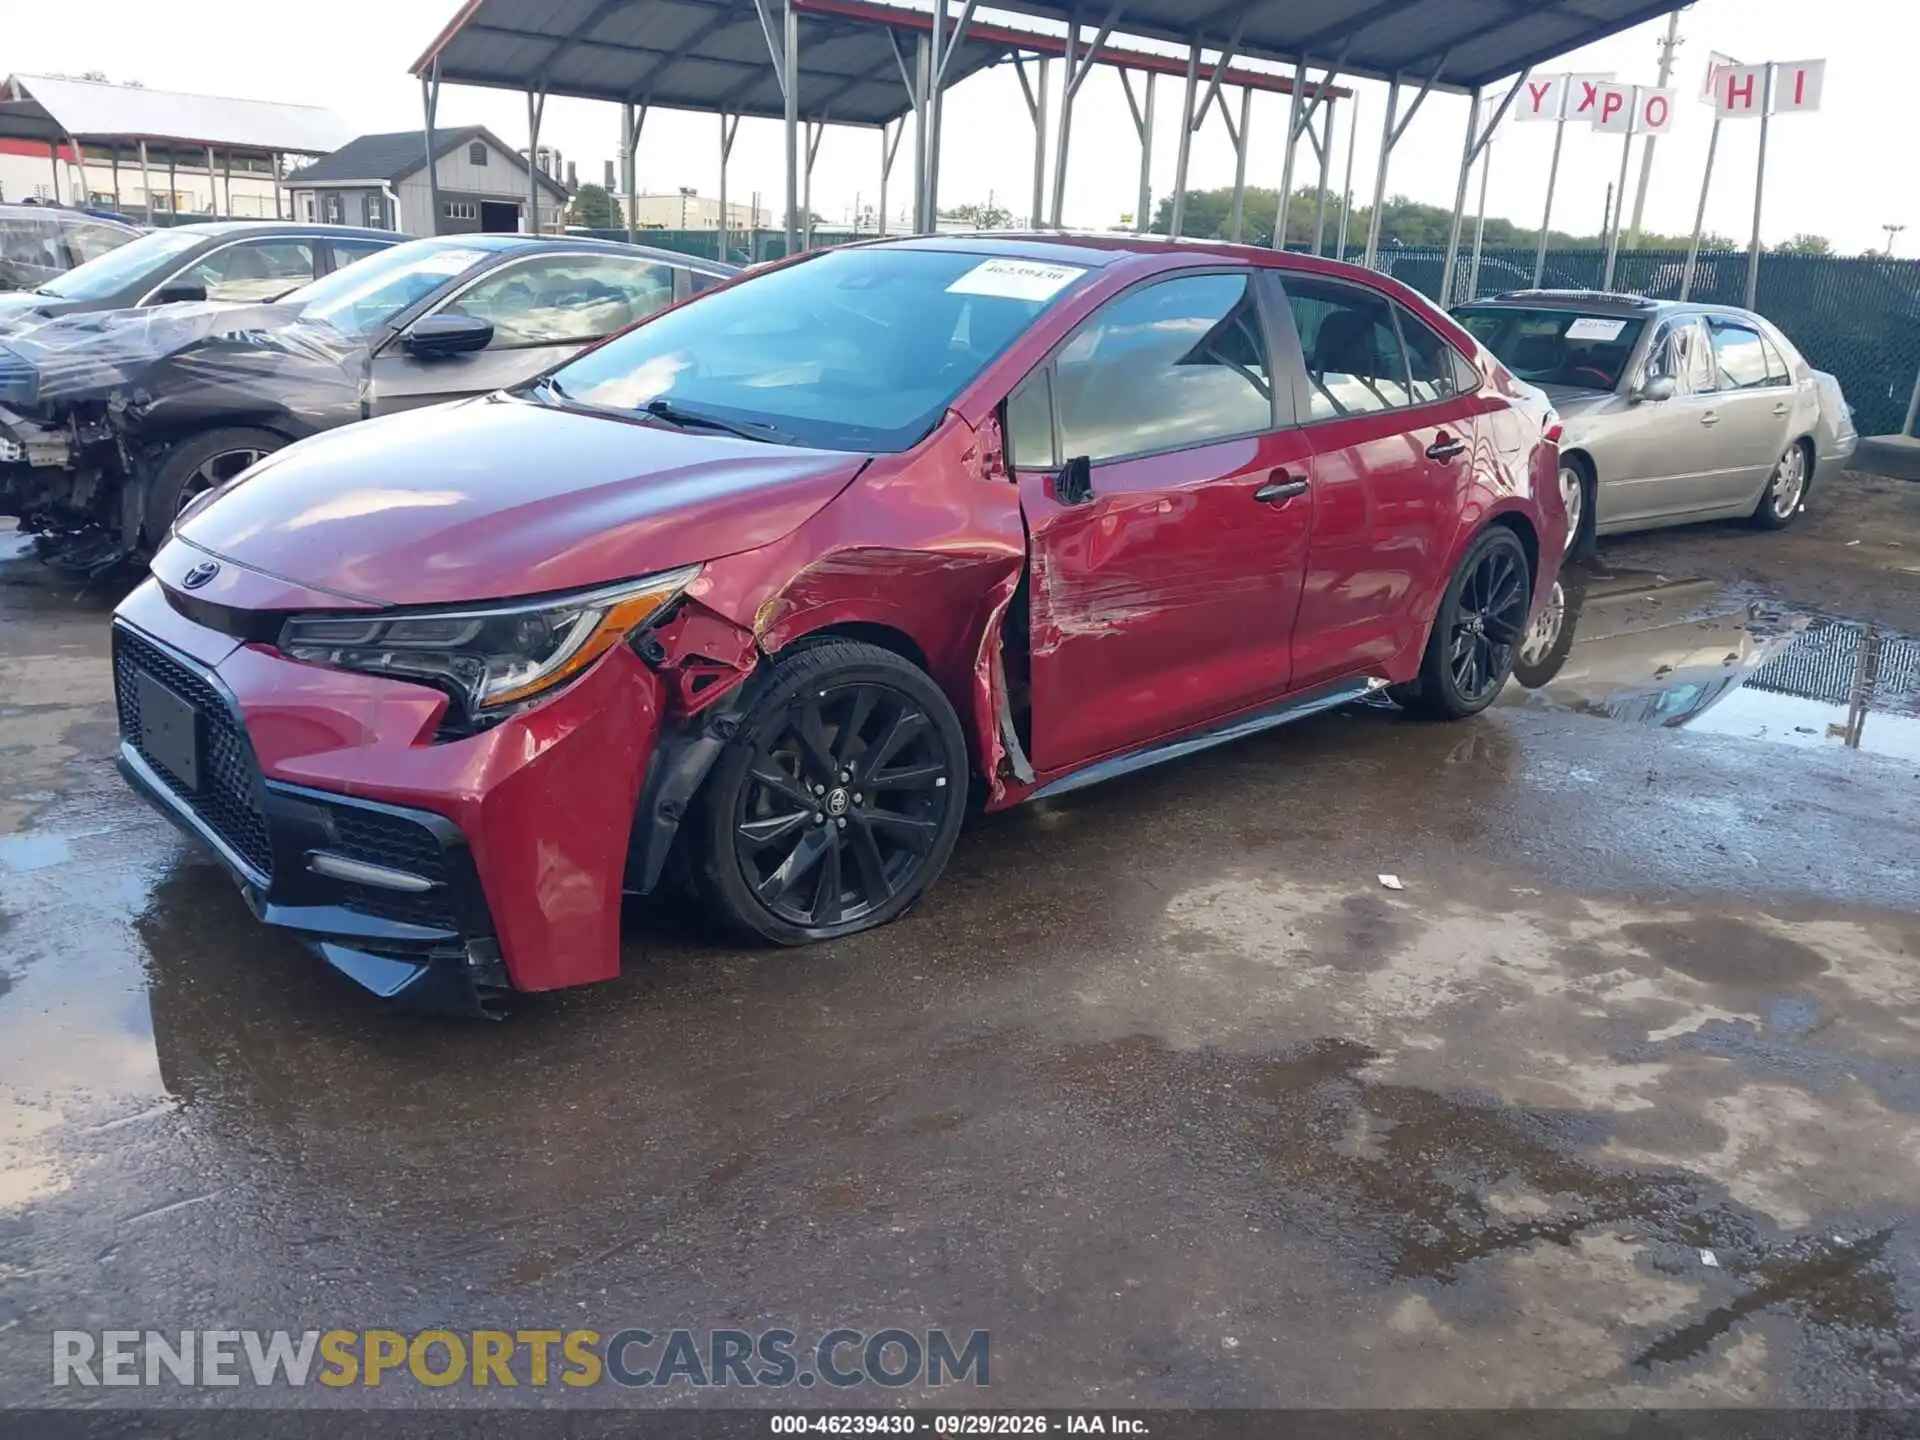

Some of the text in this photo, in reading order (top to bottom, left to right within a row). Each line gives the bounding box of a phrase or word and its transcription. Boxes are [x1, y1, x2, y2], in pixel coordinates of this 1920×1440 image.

[1528, 82, 1552, 113] Y
[1727, 74, 1754, 109] H
[1795, 70, 1804, 104] I
[1601, 92, 1623, 123] P
